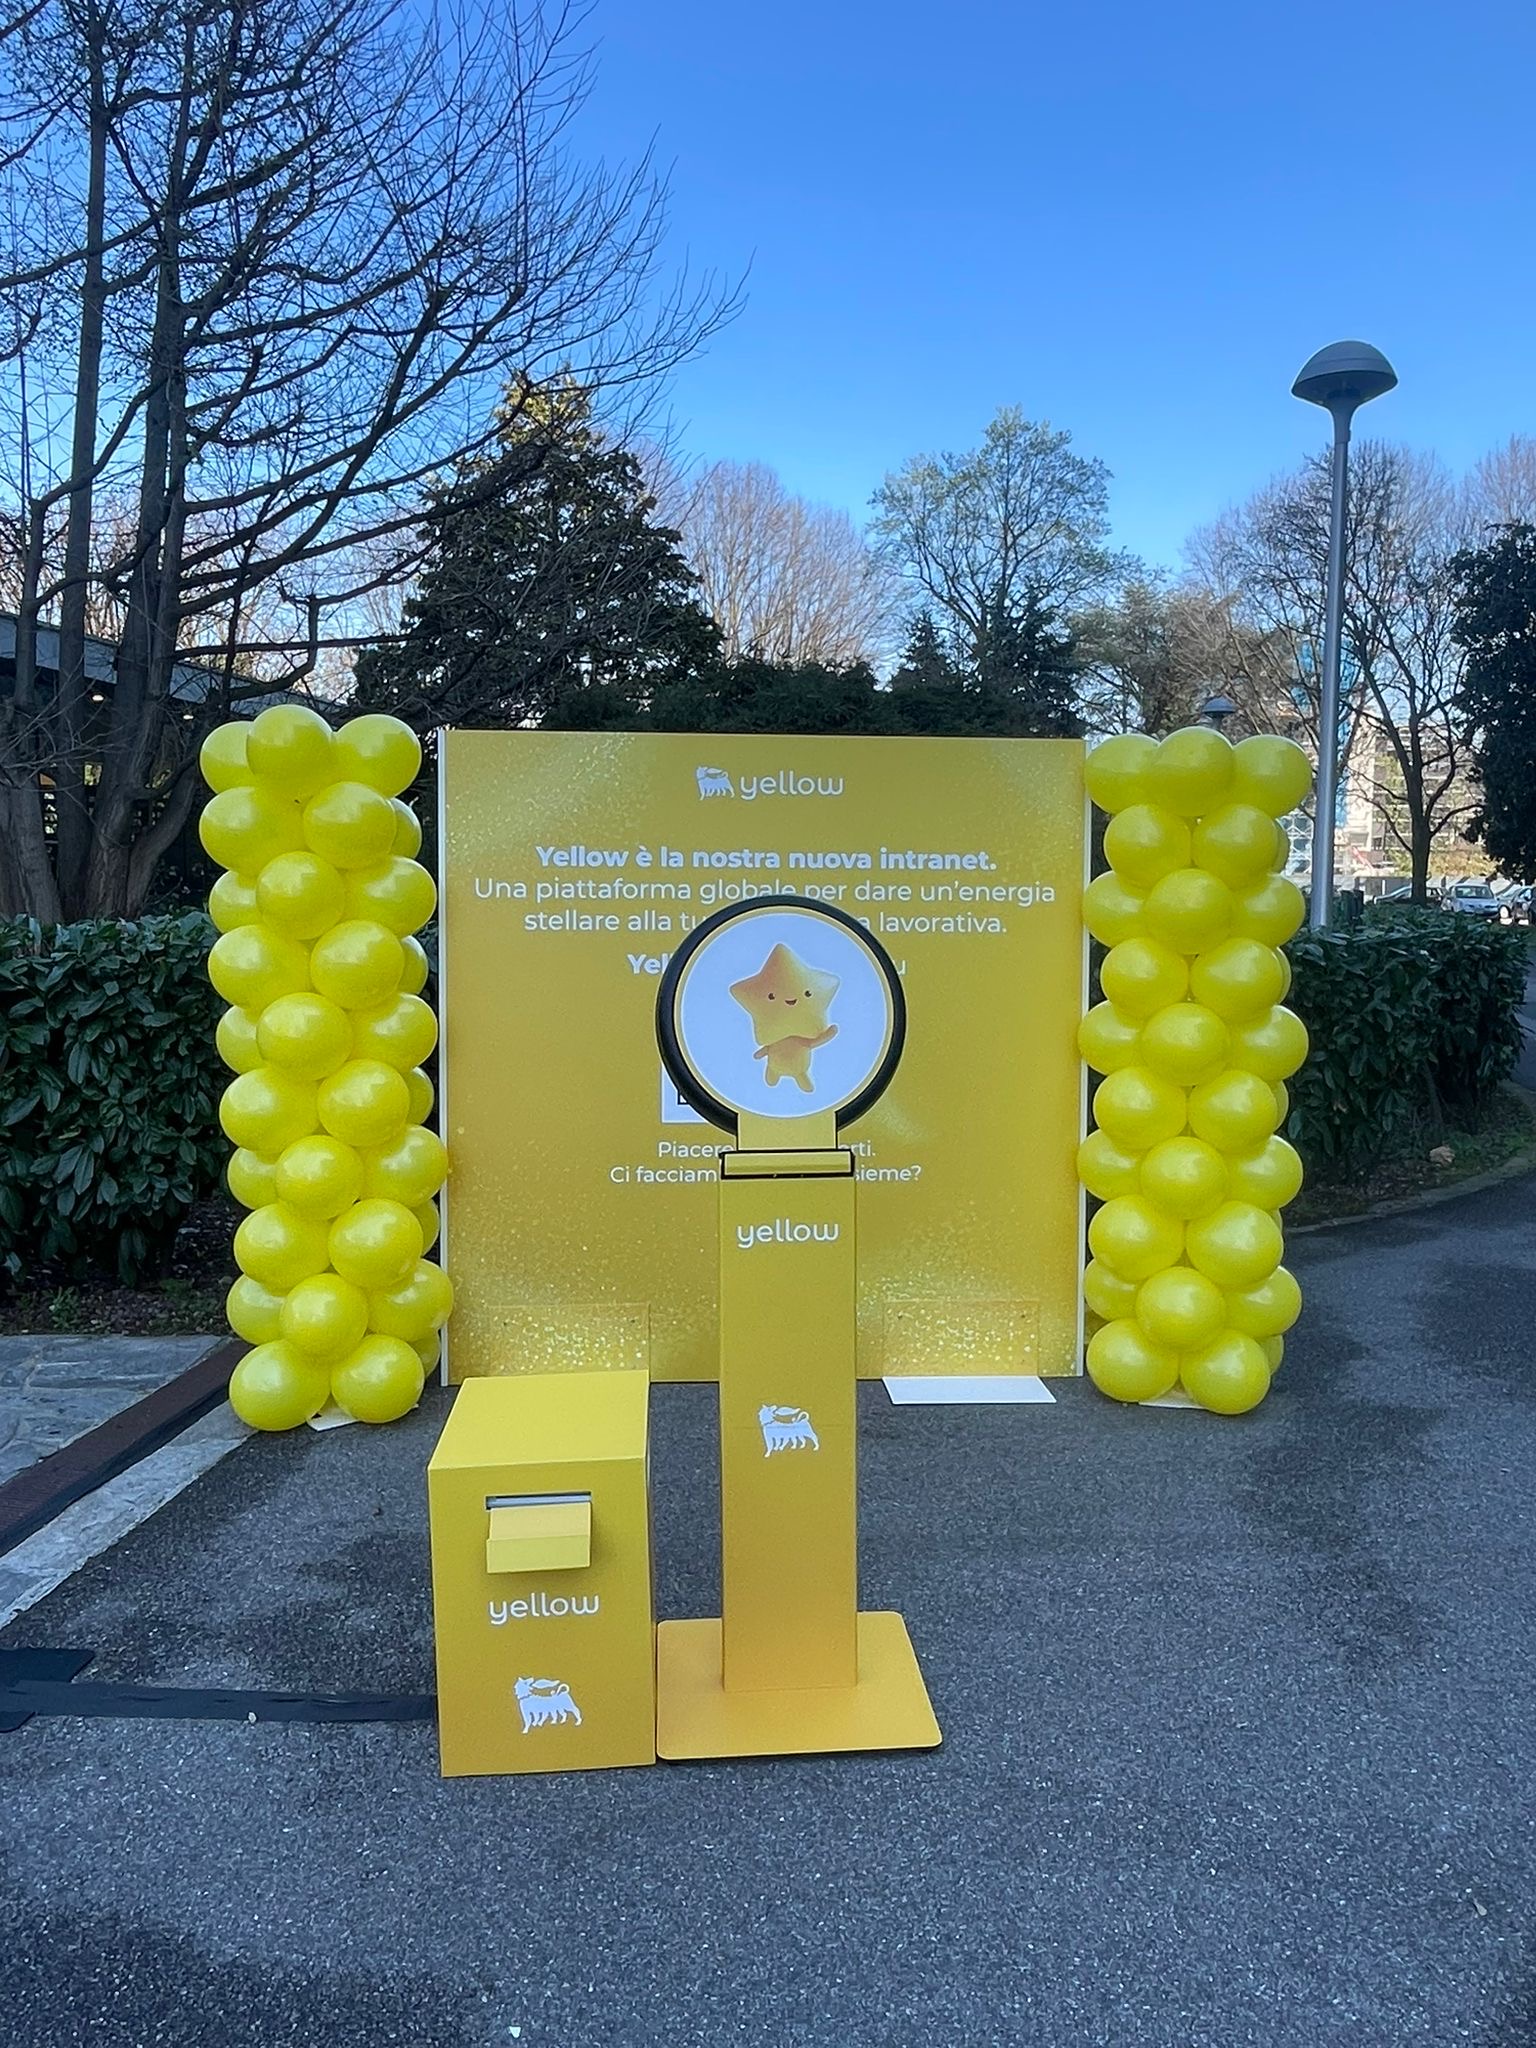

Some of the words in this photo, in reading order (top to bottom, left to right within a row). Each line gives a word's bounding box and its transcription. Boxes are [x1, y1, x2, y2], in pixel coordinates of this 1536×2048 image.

[740, 770, 844, 801] yellow
[535, 845, 629, 869] Yellow
[635, 845, 653, 869] è
[660, 845, 684, 869] la
[692, 848, 781, 869] nostra
[788, 851, 872, 870] nuova
[880, 847, 997, 871] intranet.
[474, 877, 528, 899] Una
[536, 877, 691, 903] piattaforma
[699, 879, 797, 905] globale
[804, 883, 847, 901] per
[854, 880, 912, 901] dare
[524, 910, 620, 931] stellare
[627, 910, 672, 931] alla
[880, 911, 1008, 933] lavorativa.
[626, 952, 673, 975] Yel
[609, 1166, 630, 1183] Ci
[636, 1165, 718, 1183] facciam
[736, 1218, 840, 1250] yellow
[489, 1591, 600, 1626] yellow
